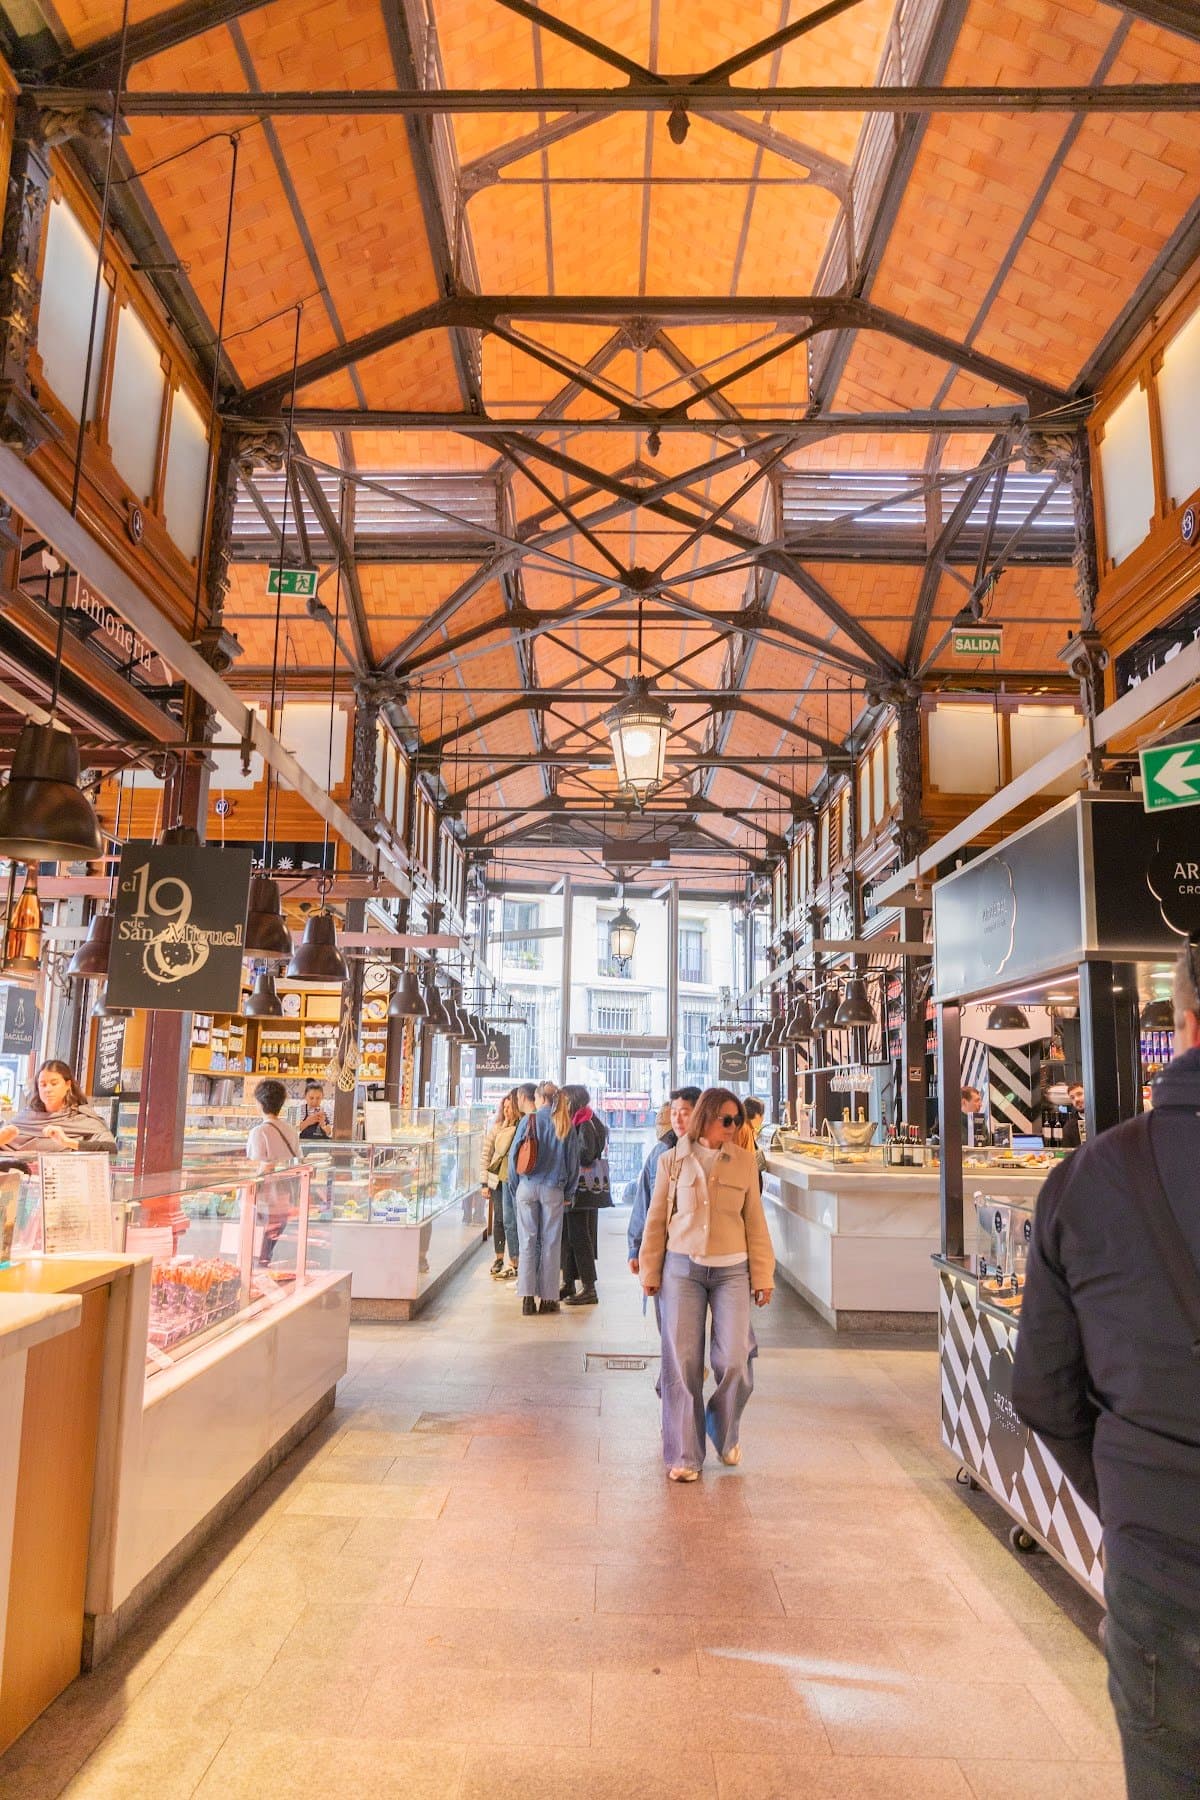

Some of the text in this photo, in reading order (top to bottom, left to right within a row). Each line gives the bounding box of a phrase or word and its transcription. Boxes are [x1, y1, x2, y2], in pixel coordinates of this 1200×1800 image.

[955, 638, 1000, 651] SALIDA
[121, 875, 137, 892] el
[130, 916, 145, 929] de
[118, 920, 242, 953] San Miguel
